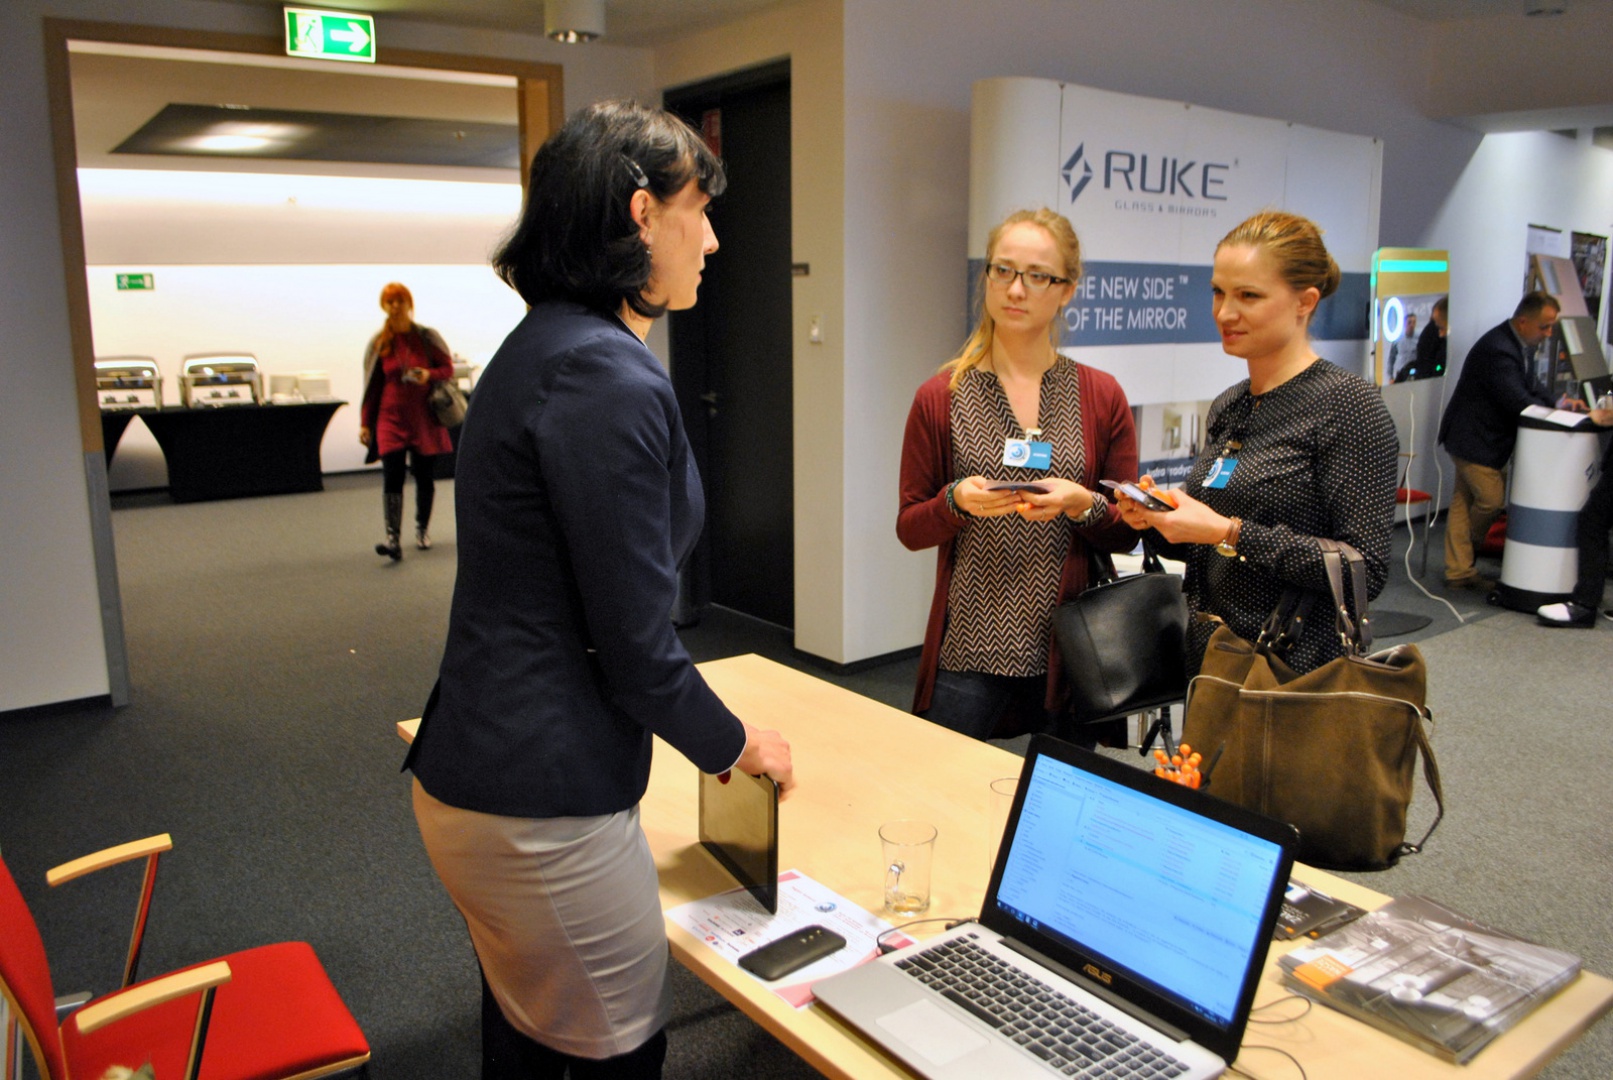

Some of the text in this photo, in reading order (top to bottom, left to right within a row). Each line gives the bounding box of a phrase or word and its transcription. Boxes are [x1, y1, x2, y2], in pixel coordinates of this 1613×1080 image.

[1104, 151, 1229, 201] RUKE
[1114, 200, 1155, 212] GLASS
[1073, 275, 1096, 300] HE
[1100, 276, 1139, 300] NEW
[1142, 277, 1174, 300] SIDE
[1065, 307, 1188, 332] OF THE MIRROR
[1083, 963, 1112, 985] ASUS
